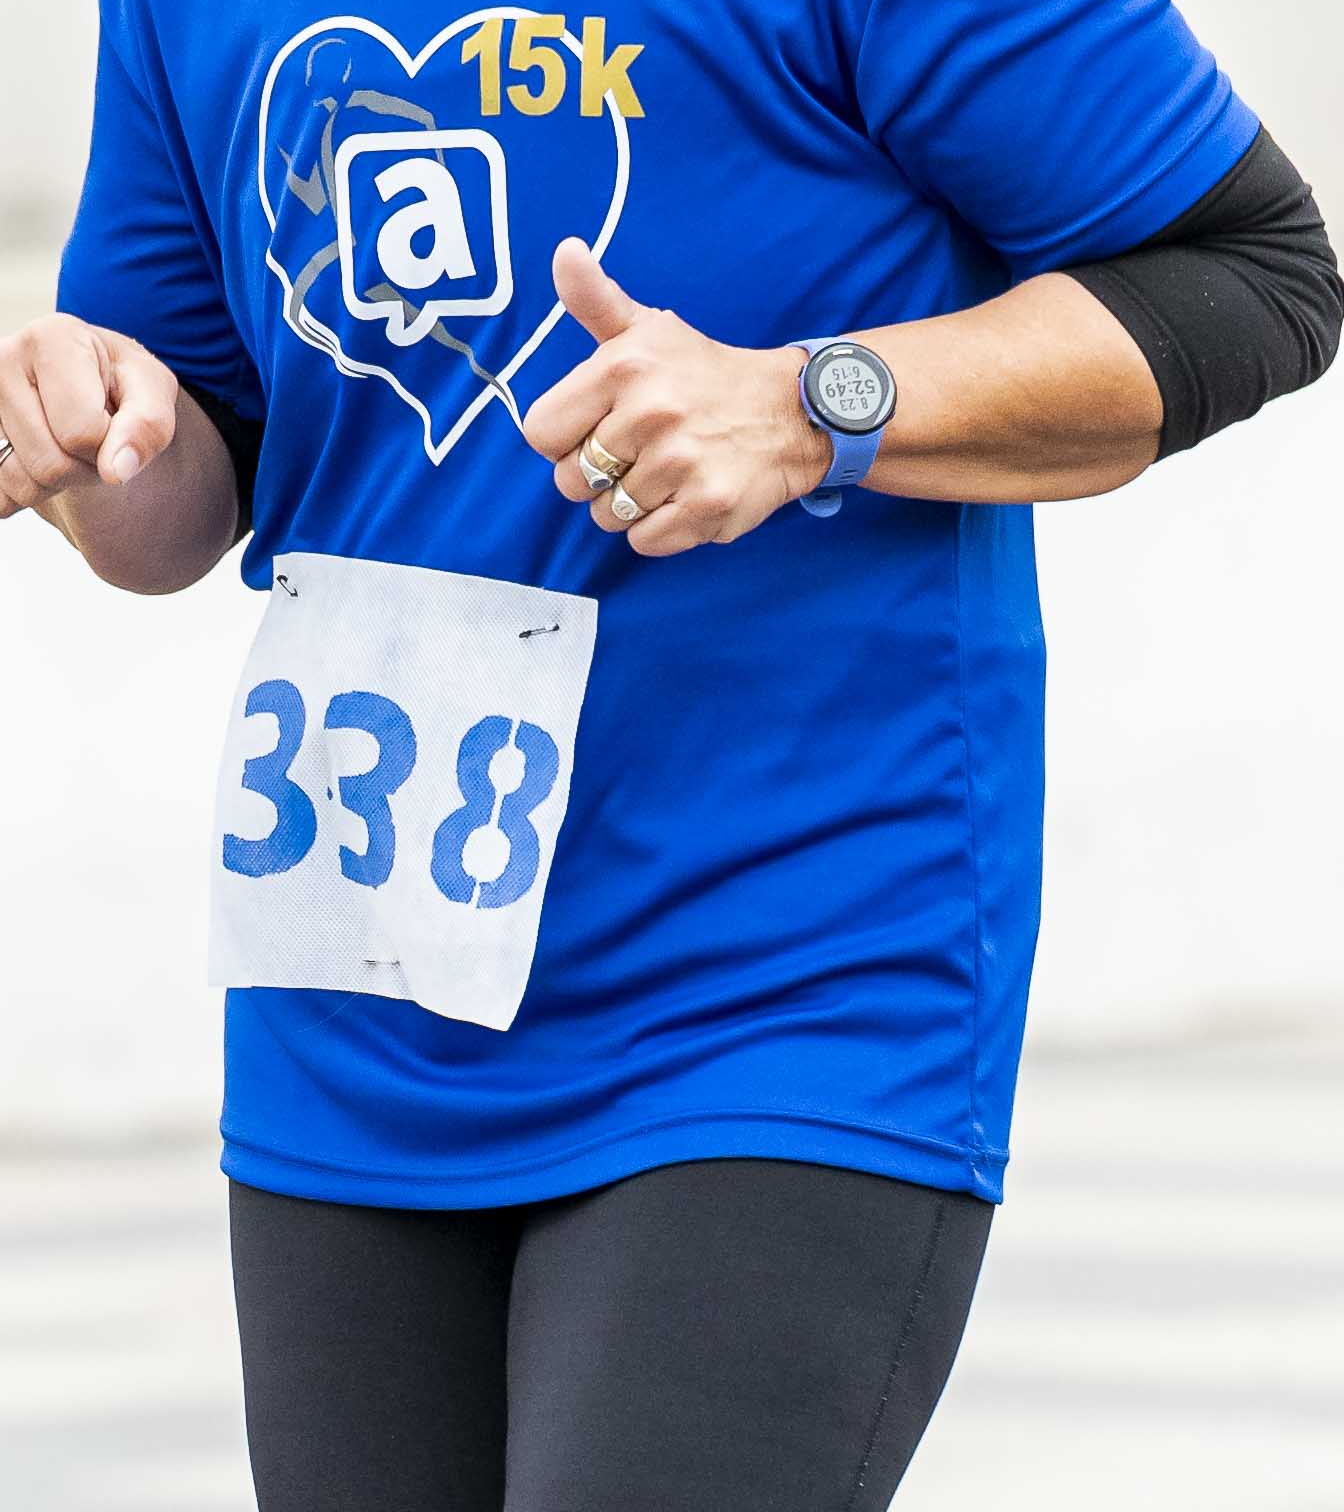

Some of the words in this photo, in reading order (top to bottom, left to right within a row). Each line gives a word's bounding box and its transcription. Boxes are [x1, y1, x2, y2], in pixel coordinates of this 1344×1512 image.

[460, 14, 645, 119] 15k
[373, 157, 477, 290] a
[825, 379, 876, 398] 52:49
[222, 678, 560, 909] 338
